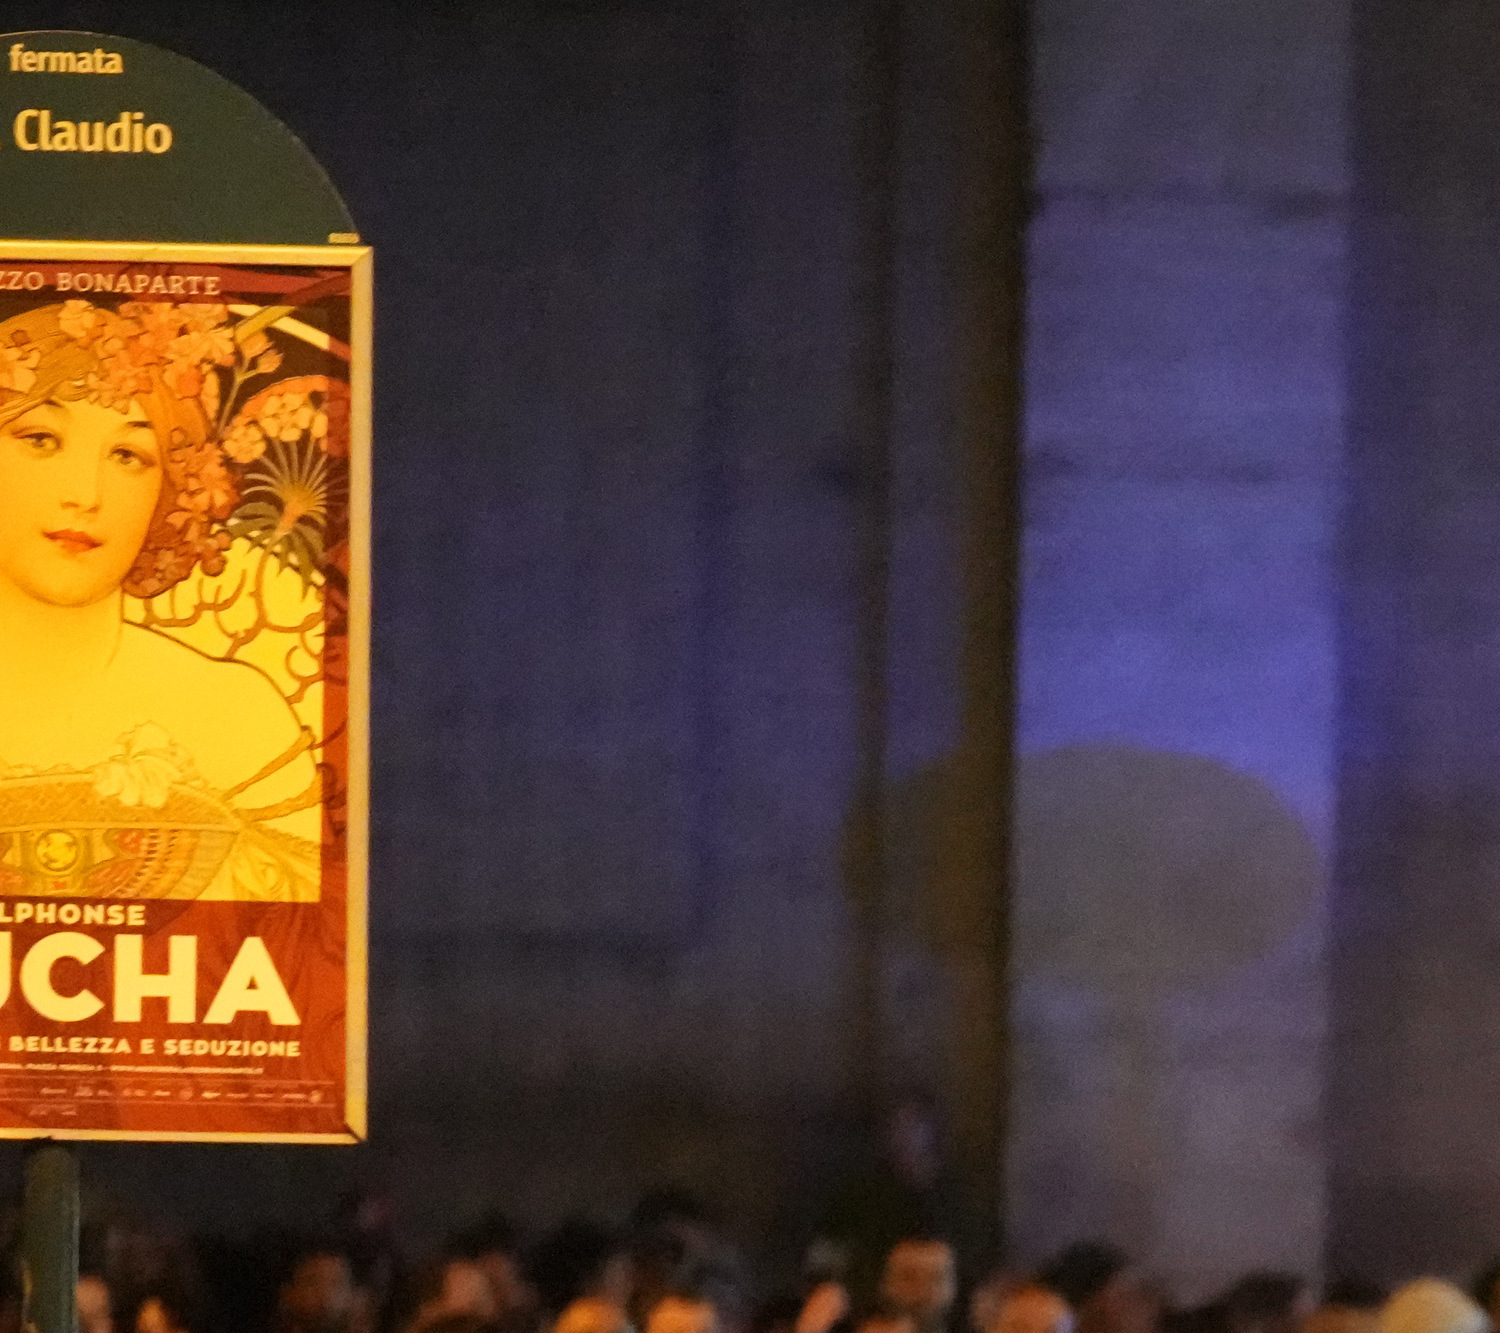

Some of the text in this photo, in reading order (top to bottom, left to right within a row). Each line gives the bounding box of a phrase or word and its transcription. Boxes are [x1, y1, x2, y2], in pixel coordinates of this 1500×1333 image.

[8, 43, 124, 74] fermata
[13, 108, 174, 154] Claudio
[56, 272, 221, 296] BONAPARTE
[0, 930, 301, 1026] CHA
[9, 1035, 301, 1057] BELLEZZA E SEDUZIONE
